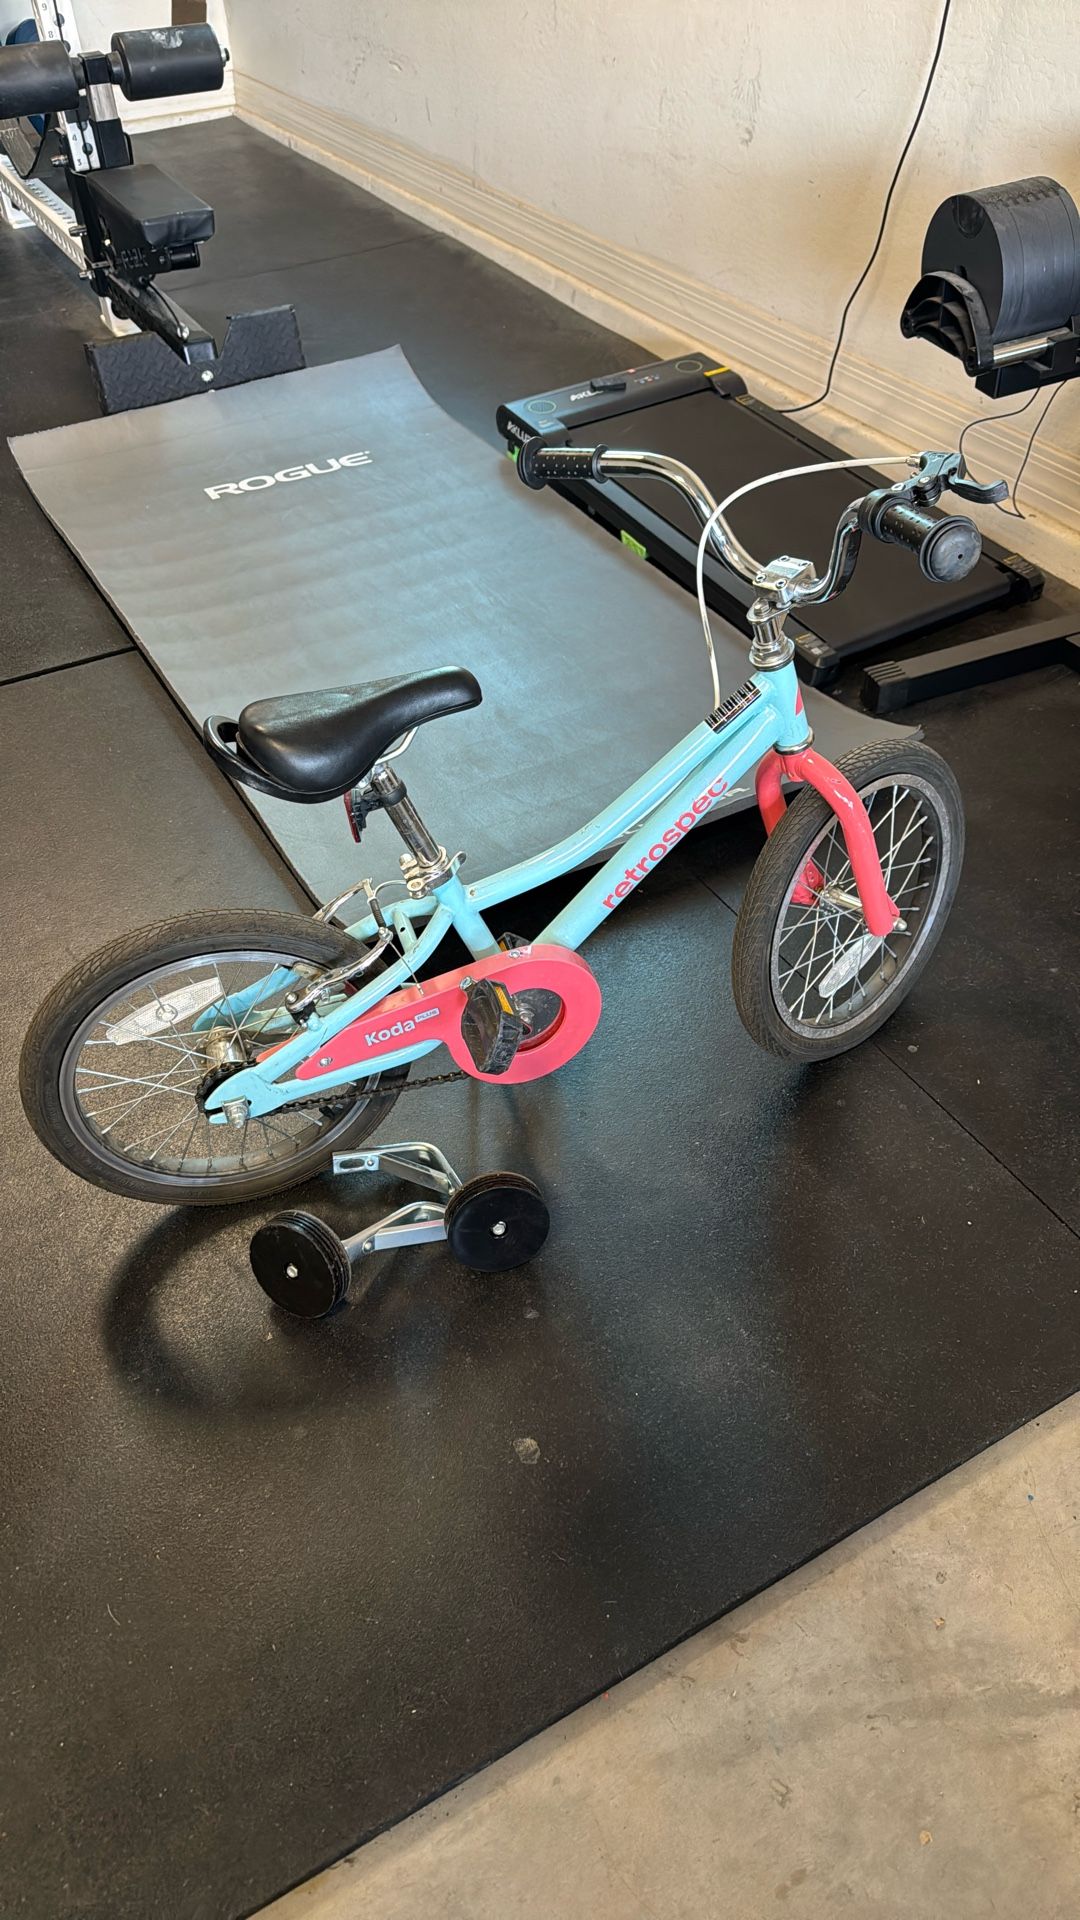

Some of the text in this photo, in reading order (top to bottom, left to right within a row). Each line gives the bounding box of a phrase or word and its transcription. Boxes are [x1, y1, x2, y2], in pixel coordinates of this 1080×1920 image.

[42, 3, 48, 11] 9
[48, 30, 54, 39] 8
[203, 451, 373, 500] ROGUE
[602, 777, 729, 909] retrospec
[364, 1009, 438, 1046] Koda PLUS
